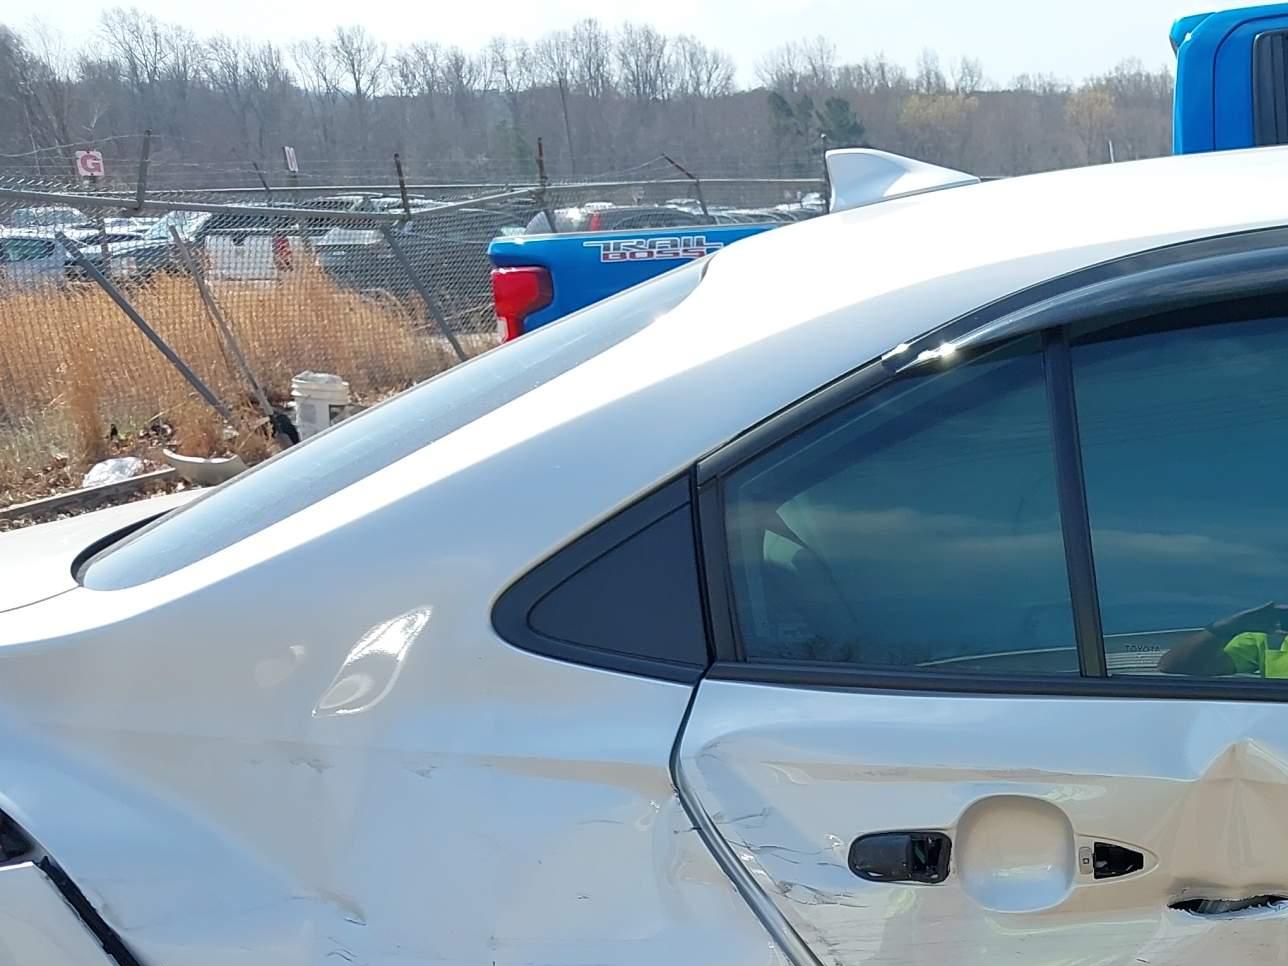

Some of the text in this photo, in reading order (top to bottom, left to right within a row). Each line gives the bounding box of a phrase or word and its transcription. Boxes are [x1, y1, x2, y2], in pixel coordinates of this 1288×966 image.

[80, 153, 103, 173] G
[583, 236, 723, 251] TRAIL
[601, 248, 706, 262] BOSS
